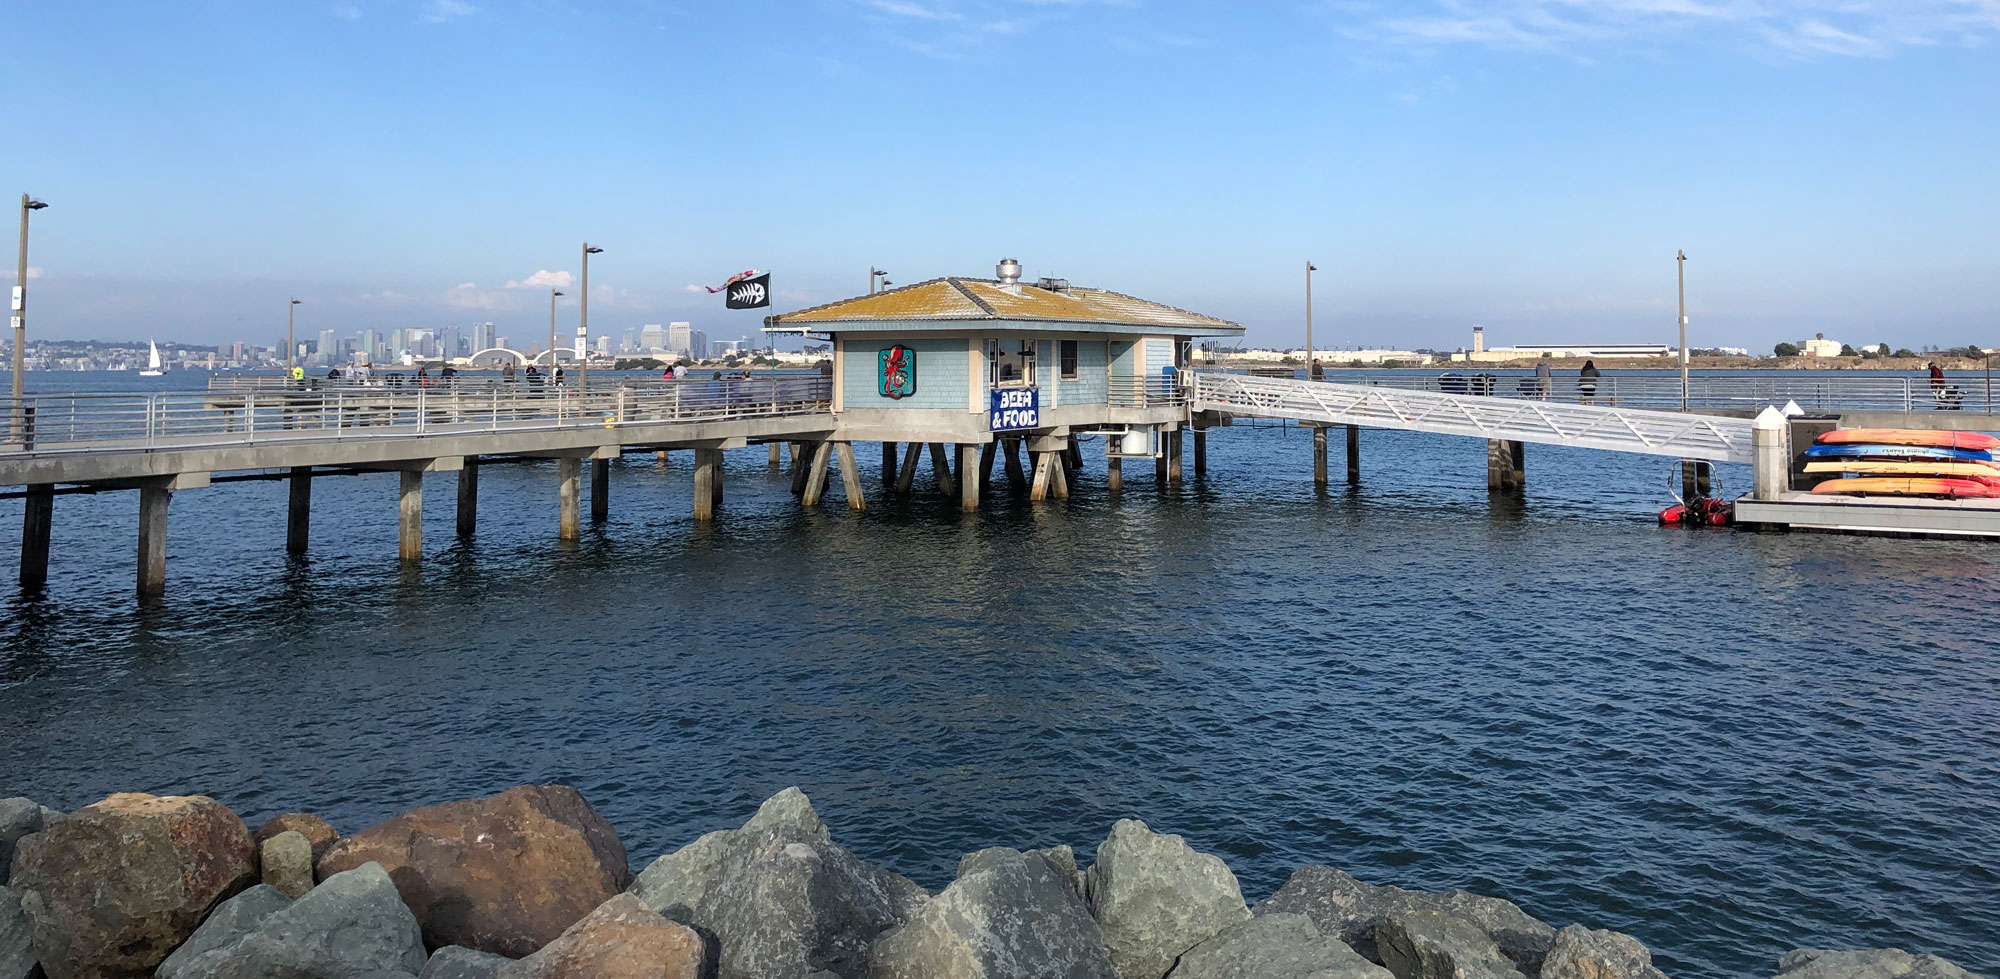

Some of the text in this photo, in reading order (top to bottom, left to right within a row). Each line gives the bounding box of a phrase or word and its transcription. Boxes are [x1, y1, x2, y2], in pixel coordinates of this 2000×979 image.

[1000, 391, 1032, 408] BEER
[992, 409, 1037, 429] & FOOD
